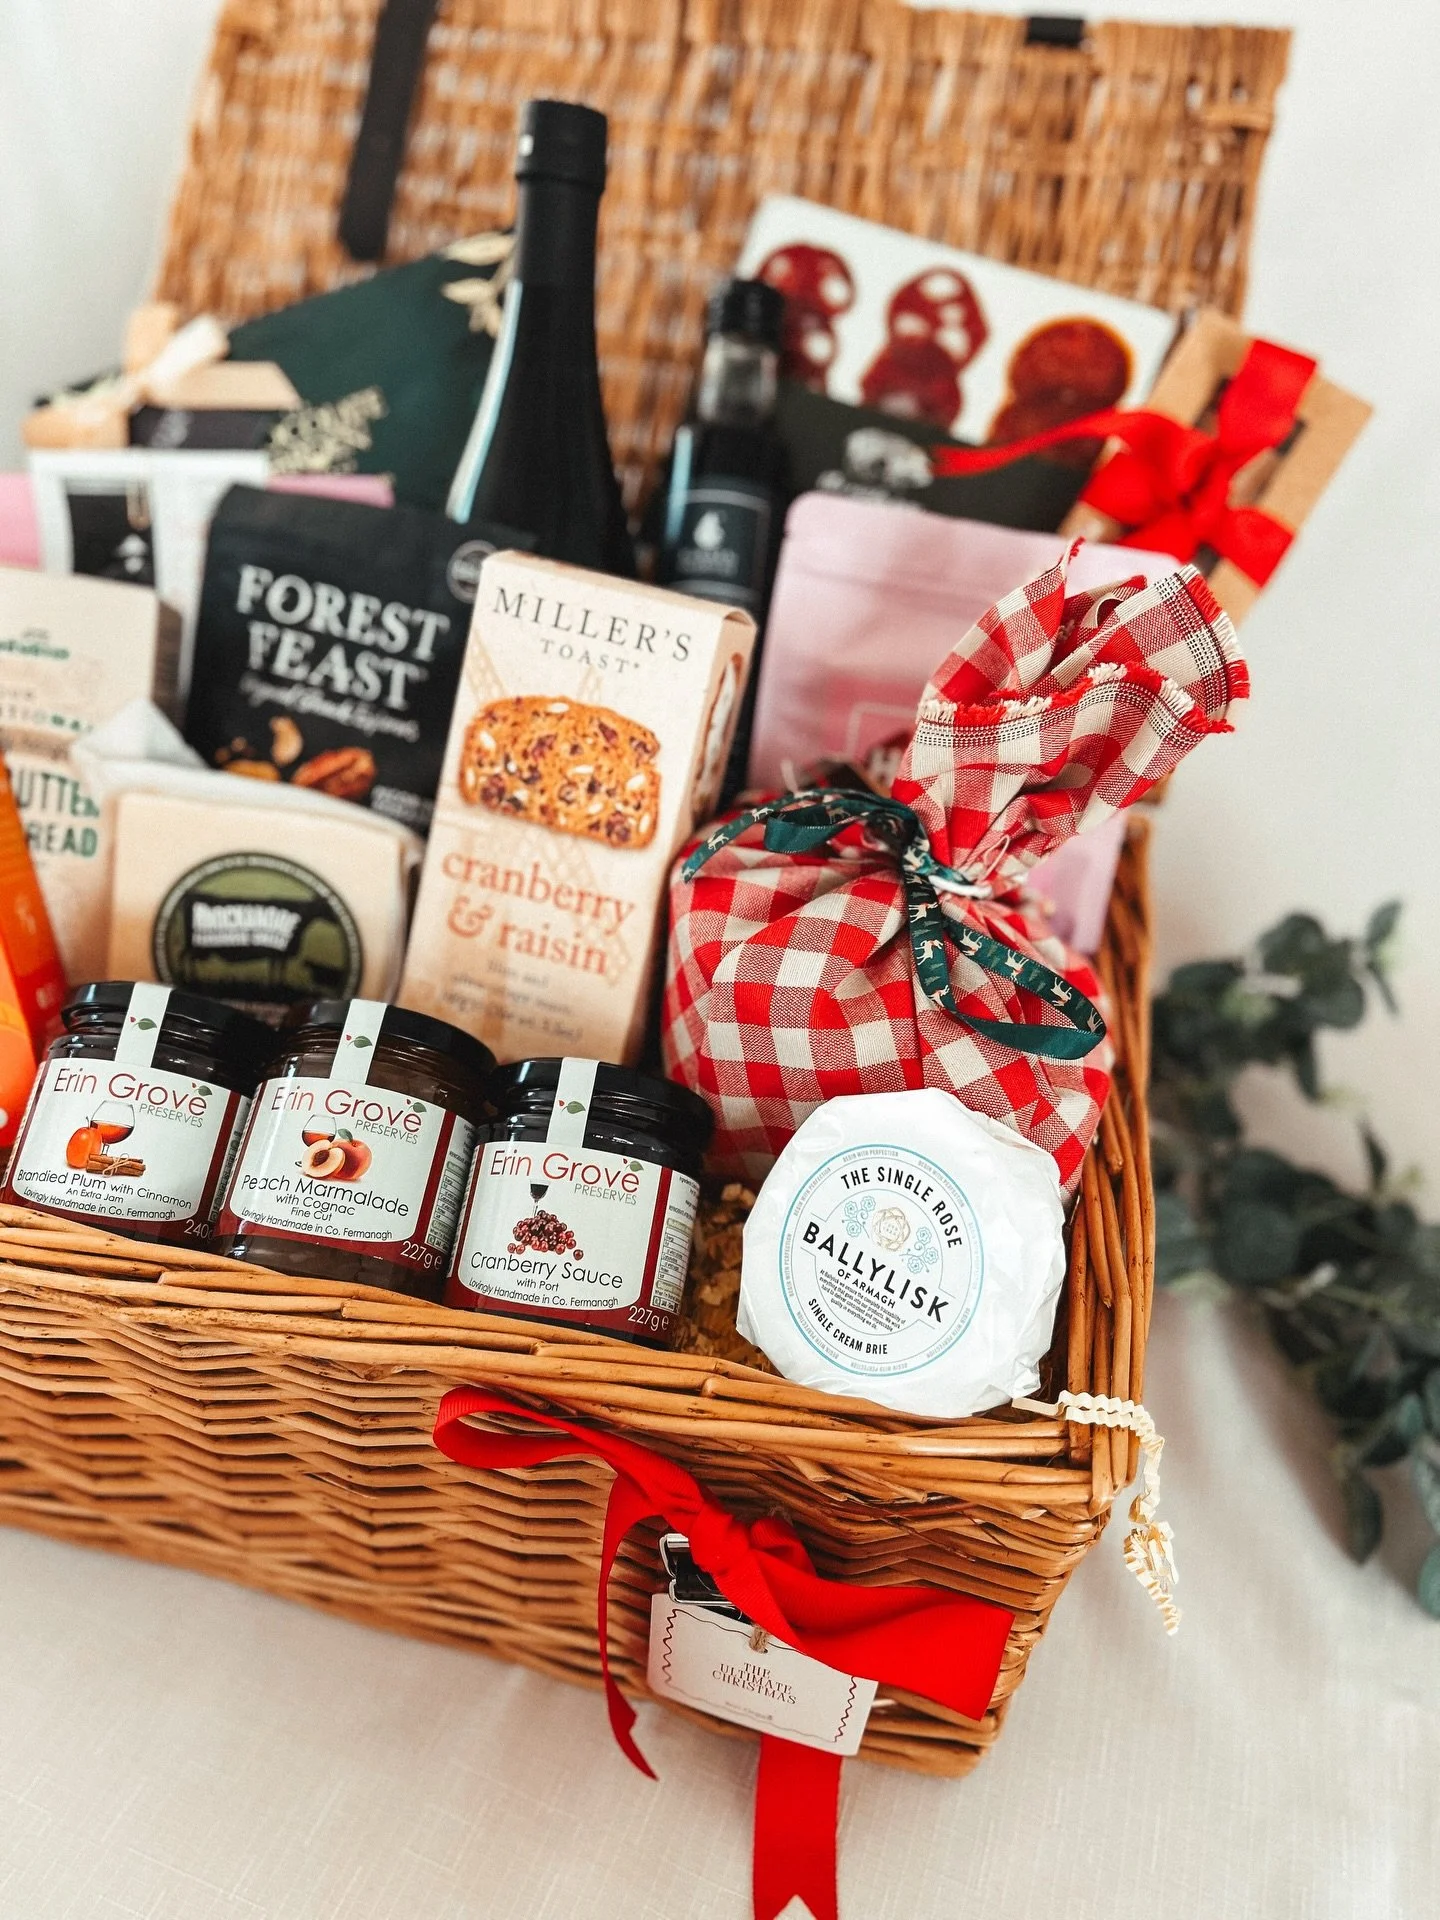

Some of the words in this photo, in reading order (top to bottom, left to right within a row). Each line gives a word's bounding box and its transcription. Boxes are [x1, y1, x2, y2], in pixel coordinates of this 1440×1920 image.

[236, 564, 450, 661] FOREST
[493, 588, 692, 662] MILLER'S
[248, 621, 429, 711] FEAST
[442, 851, 635, 936] cranberry
[447, 895, 495, 938] &
[498, 922, 607, 976] raisin
[54, 1068, 97, 1093] Erin
[109, 1073, 207, 1116] Grove
[272, 1086, 314, 1111] Erin
[325, 1090, 422, 1133] Grove
[139, 1104, 203, 1128] PRESERVES
[355, 1120, 418, 1144] PRESERVES
[17, 1170, 67, 1184] Brandied
[71, 1174, 107, 1190] Plum
[110, 1183, 134, 1196] with
[137, 1188, 192, 1209] Cinnamon
[490, 1150, 532, 1177] Erin
[543, 1153, 639, 1193] Grove
[24, 1187, 49, 1204] Lovingly
[49, 1195, 96, 1212] Handmade
[99, 1204, 106, 1213] in
[108, 1206, 124, 1216] Co.
[127, 1208, 175, 1220] Fermanagh
[66, 1188, 78, 1197] An
[81, 1189, 101, 1200] Extra
[104, 1192, 123, 1203] Jam
[242, 1175, 290, 1191] Peach
[295, 1179, 409, 1217] Marmalade
[275, 1194, 299, 1206] with
[302, 1197, 355, 1216] Cognac
[574, 1184, 637, 1205] PRESERVES
[841, 1168, 871, 1190] THE
[877, 1167, 934, 1202] SINGLE
[932, 1201, 963, 1248] ROSE
[242, 1207, 266, 1223] Lovingly
[266, 1215, 313, 1232] Handmade
[314, 1223, 322, 1232] in
[325, 1225, 341, 1236] Co.
[343, 1228, 393, 1240] Fermanagh
[290, 1207, 313, 1219] Fine
[316, 1211, 332, 1221] Cut
[471, 1252, 557, 1279] Cranberry
[562, 1262, 622, 1289] Sauce
[516, 1278, 536, 1289] with
[539, 1281, 559, 1291] Port
[802, 1222, 949, 1323] BALLYLISK
[838, 1269, 851, 1279] OF
[852, 1279, 896, 1309] ARMAGH
[469, 1278, 493, 1294] Lovingly
[494, 1286, 540, 1303] Handmade
[542, 1295, 550, 1303] in
[552, 1296, 568, 1306] Co.
[570, 1297, 619, 1308] Fermanagh
[808, 1298, 833, 1332] SINGLE
[833, 1329, 863, 1352] CREAM
[866, 1343, 888, 1355] BRIE
[712, 1670, 797, 1705] CHRISTMAS
[720, 1663, 792, 1695] ULTIMATE
[744, 1662, 771, 1678] THE
